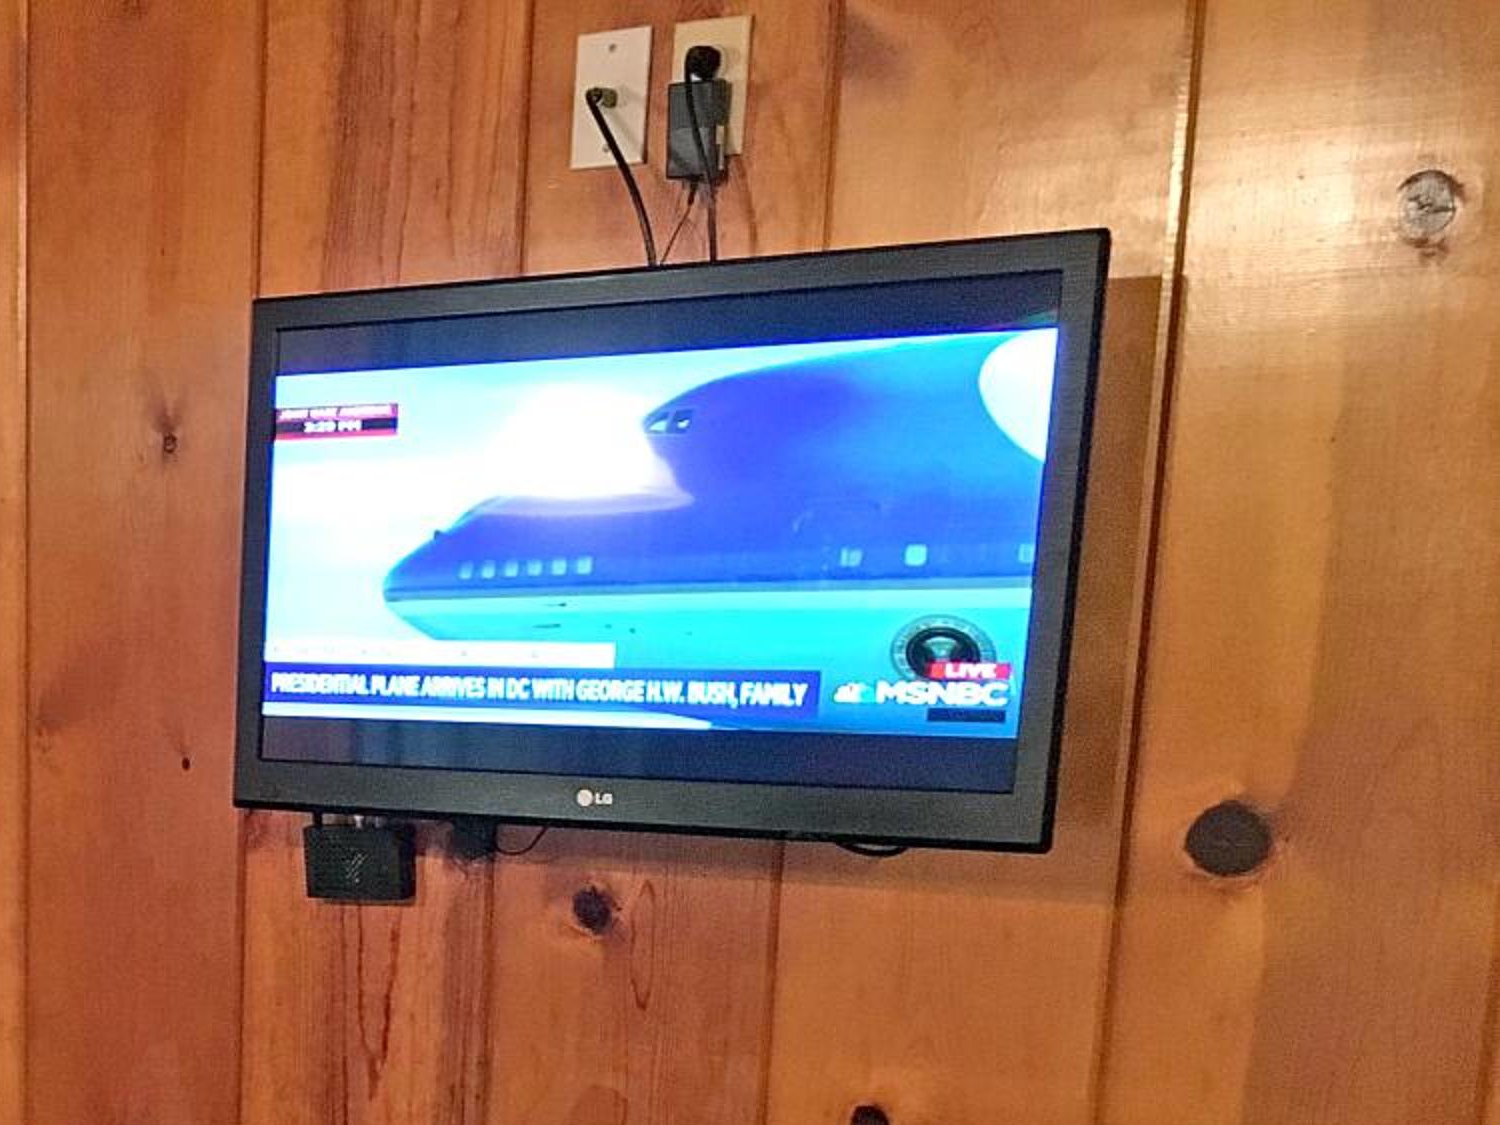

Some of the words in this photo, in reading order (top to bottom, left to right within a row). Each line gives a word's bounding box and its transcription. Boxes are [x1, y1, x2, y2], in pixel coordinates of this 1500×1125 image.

[945, 662, 997, 680] LIVE
[271, 671, 370, 696] PRESIDENTIAL
[371, 674, 421, 697] PLANE
[420, 675, 486, 698] ARRIVES
[487, 677, 505, 699] IN
[506, 677, 531, 700] DC
[531, 677, 575, 701] WITH
[575, 678, 644, 703] GEORGE
[740, 681, 809, 707] FAMILY
[875, 680, 1010, 707] MSNBC
